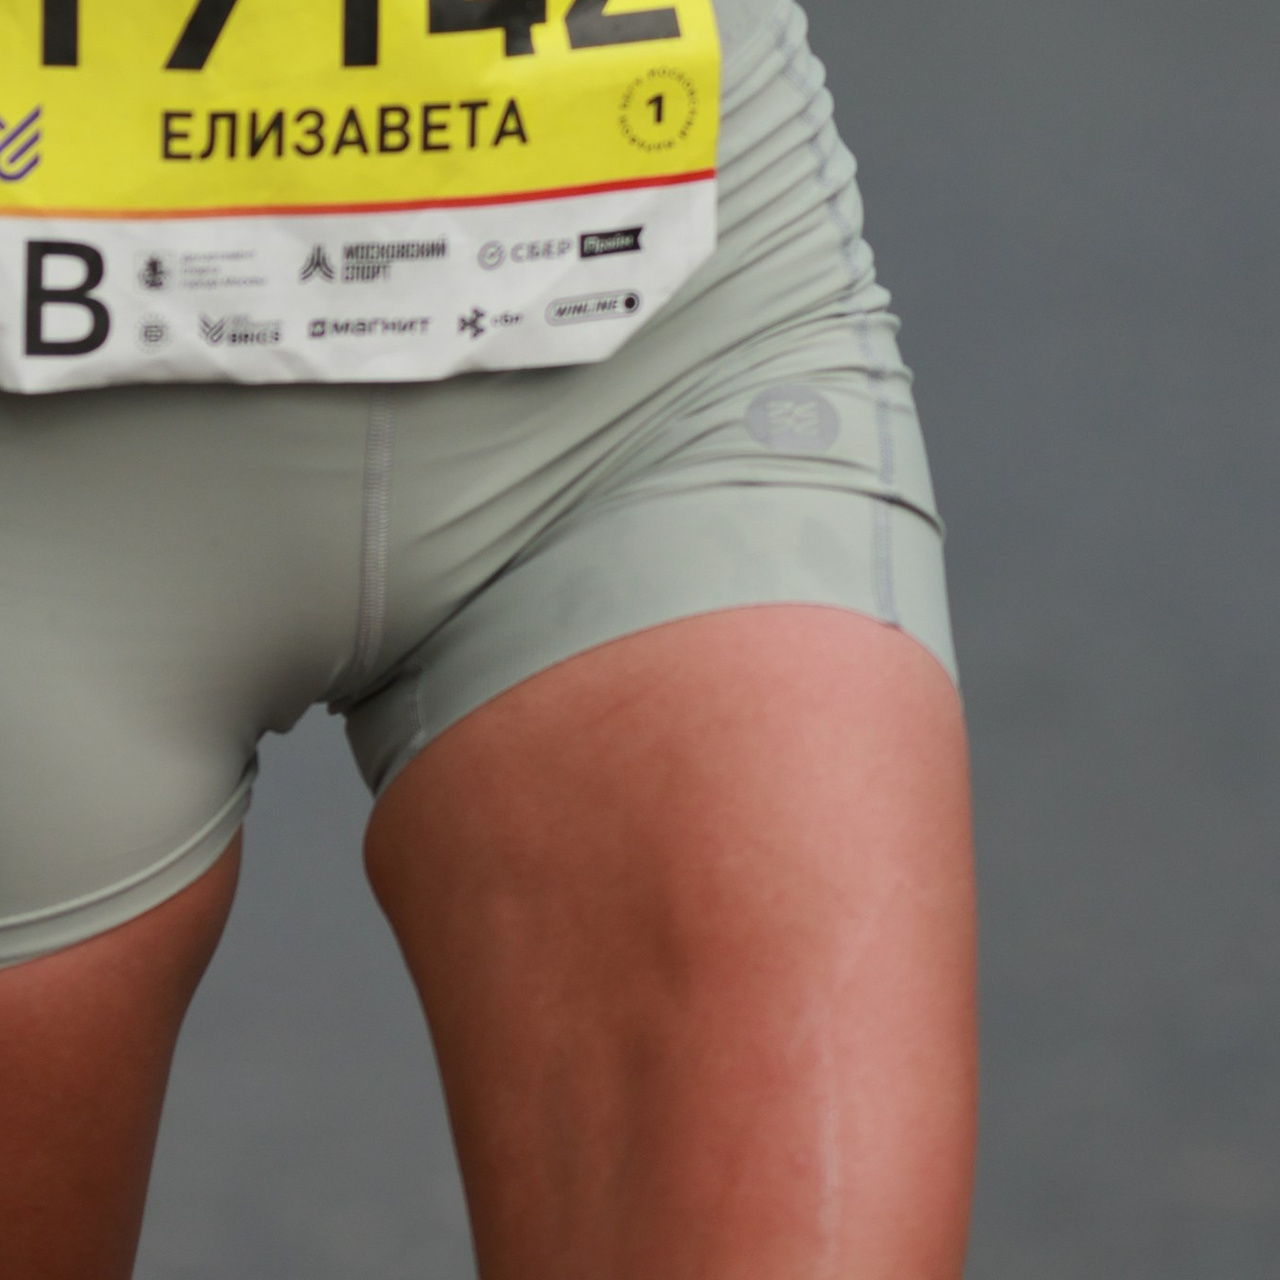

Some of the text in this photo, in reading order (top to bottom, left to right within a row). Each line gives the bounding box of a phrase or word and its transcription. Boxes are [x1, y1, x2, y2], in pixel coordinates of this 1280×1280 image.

[163, 98, 530, 160] ЕЛИЗАВЕТА
[646, 93, 664, 125] 1
[24, 239, 111, 358] B
